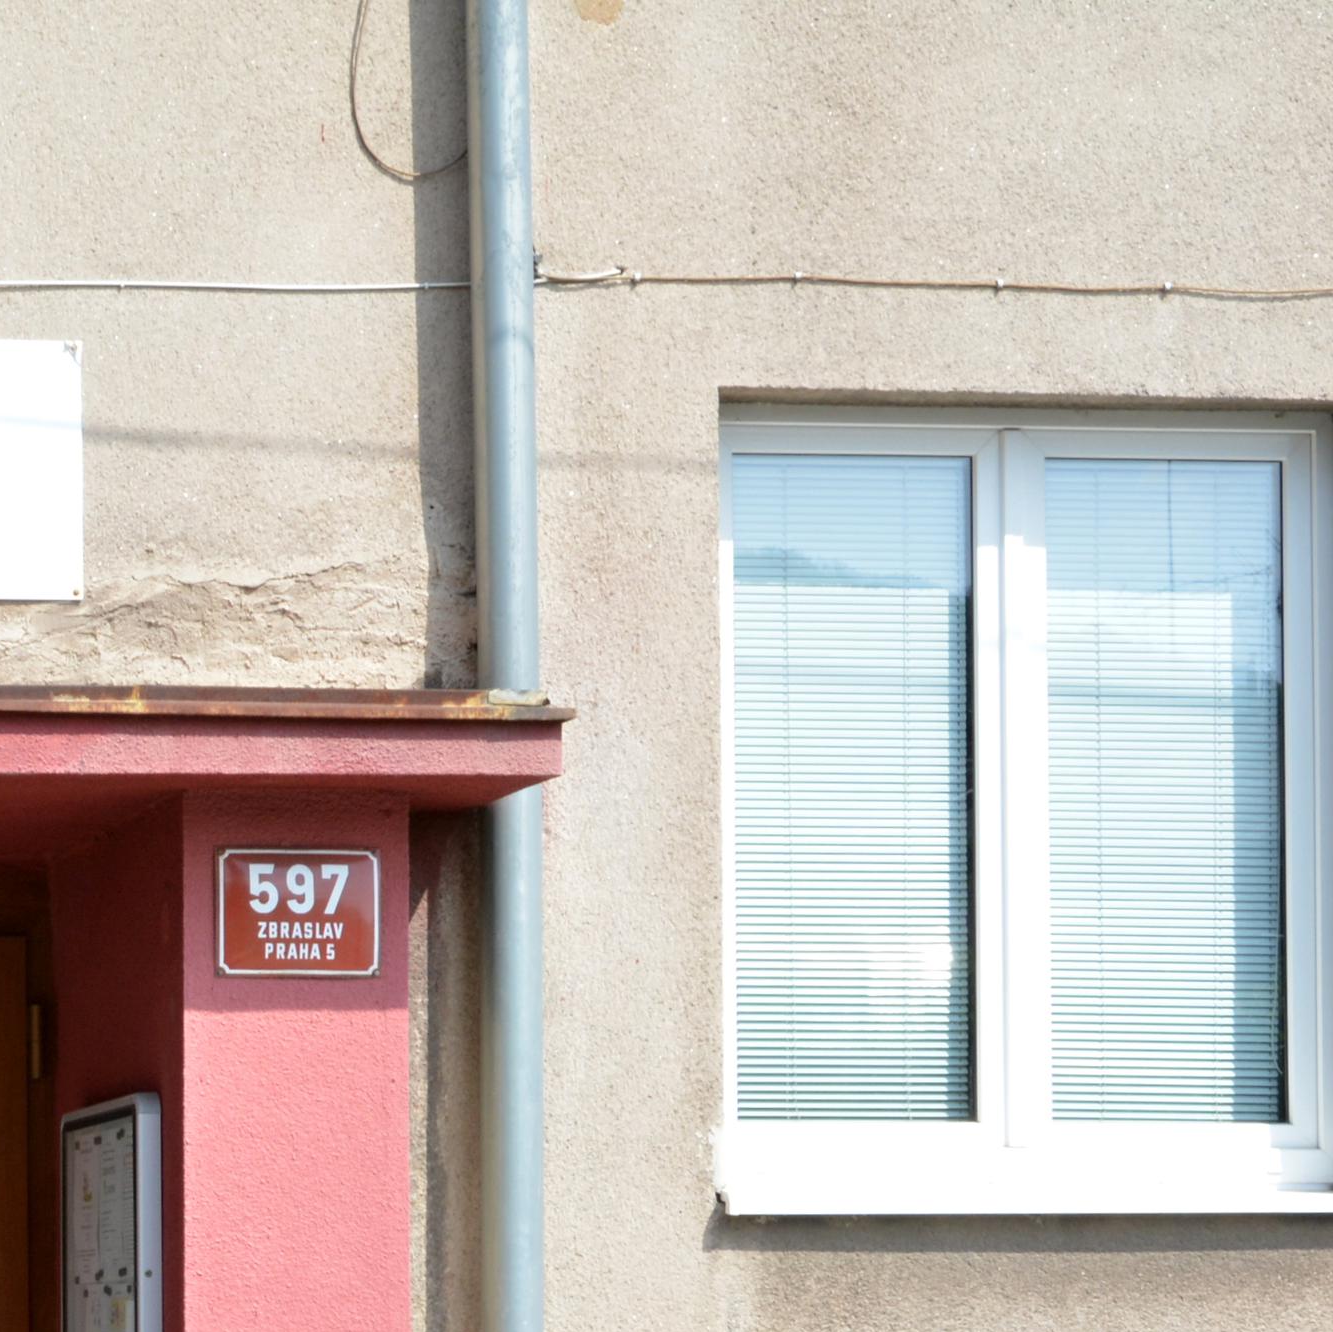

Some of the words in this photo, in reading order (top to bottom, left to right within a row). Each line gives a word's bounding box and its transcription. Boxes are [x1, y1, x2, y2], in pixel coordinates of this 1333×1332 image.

[249, 863, 349, 915] 597
[258, 922, 344, 939] ZBRASLAV
[265, 942, 321, 960] PRAHA
[326, 943, 335, 960] 5
